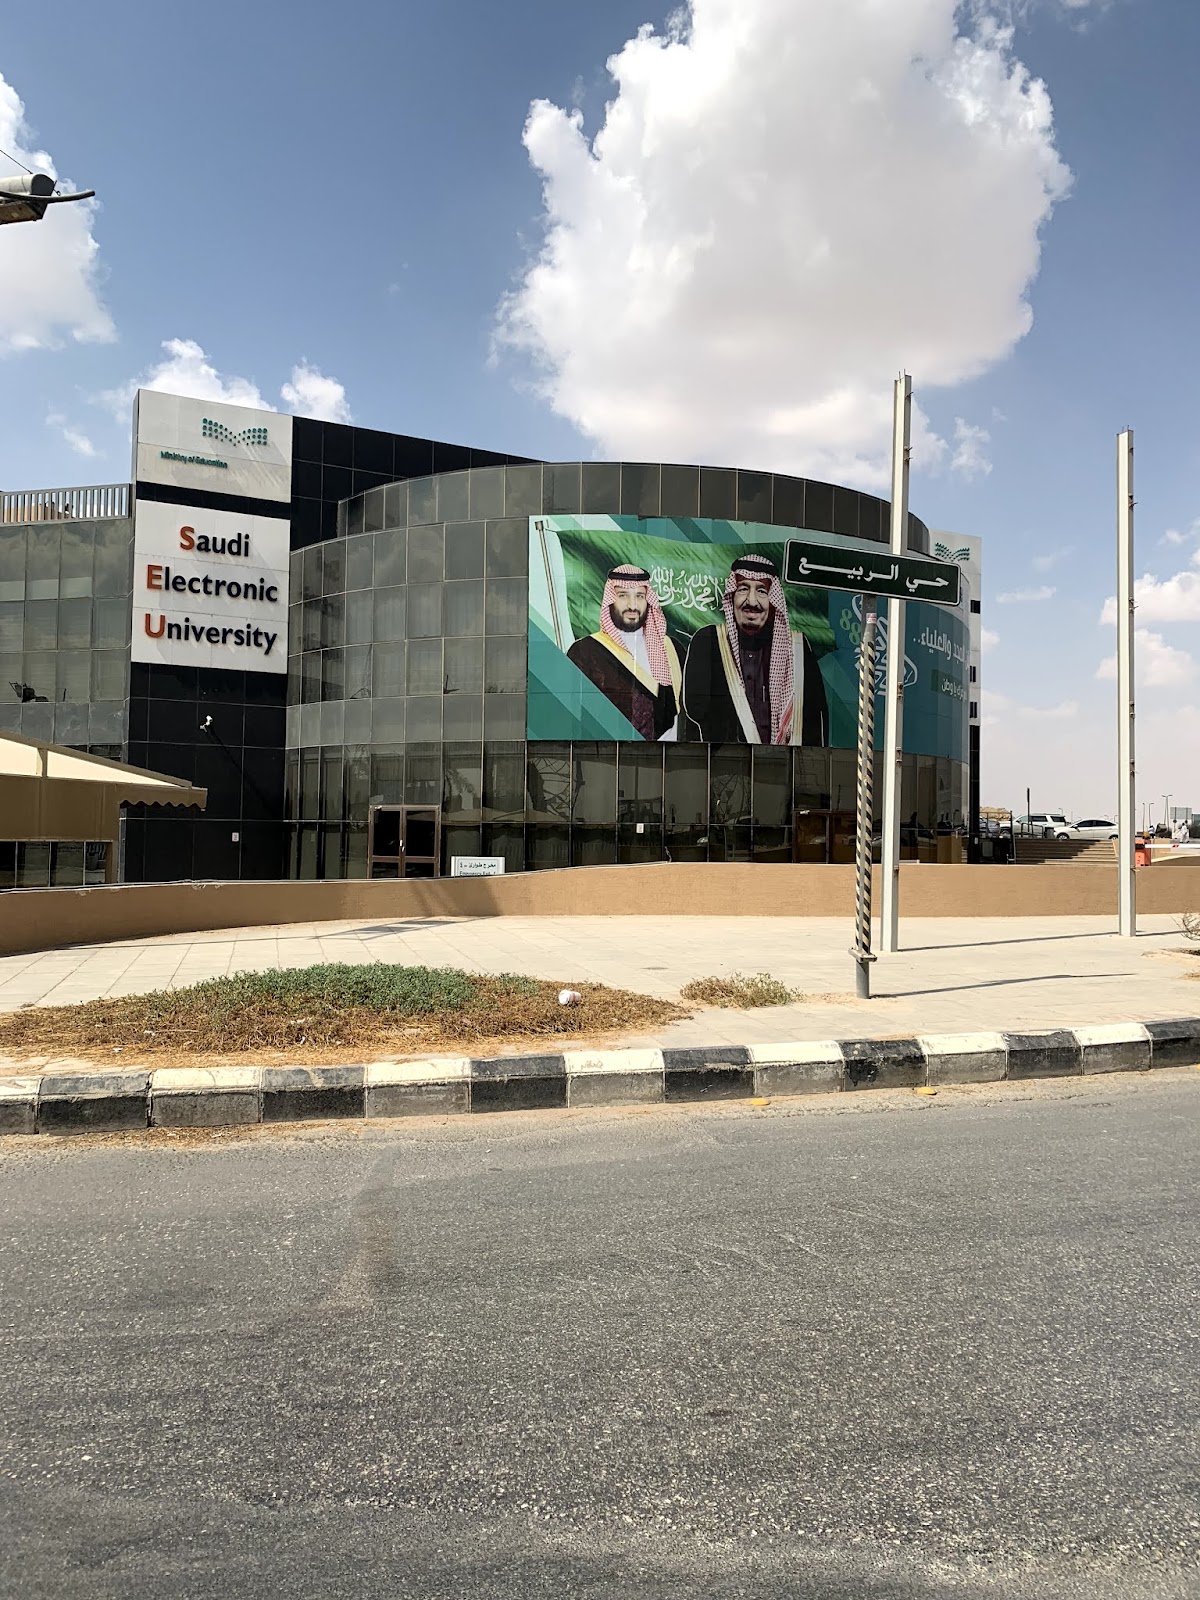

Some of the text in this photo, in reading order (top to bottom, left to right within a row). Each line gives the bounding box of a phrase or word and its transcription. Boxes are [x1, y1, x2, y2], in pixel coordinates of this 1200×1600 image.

[160, 450, 187, 464] Ministry
[195, 455, 228, 469] Education
[179, 526, 250, 557] Saudi
[146, 564, 278, 602] Electronic
[798, 556, 950, 593] حي الربيع
[144, 613, 278, 655] University
